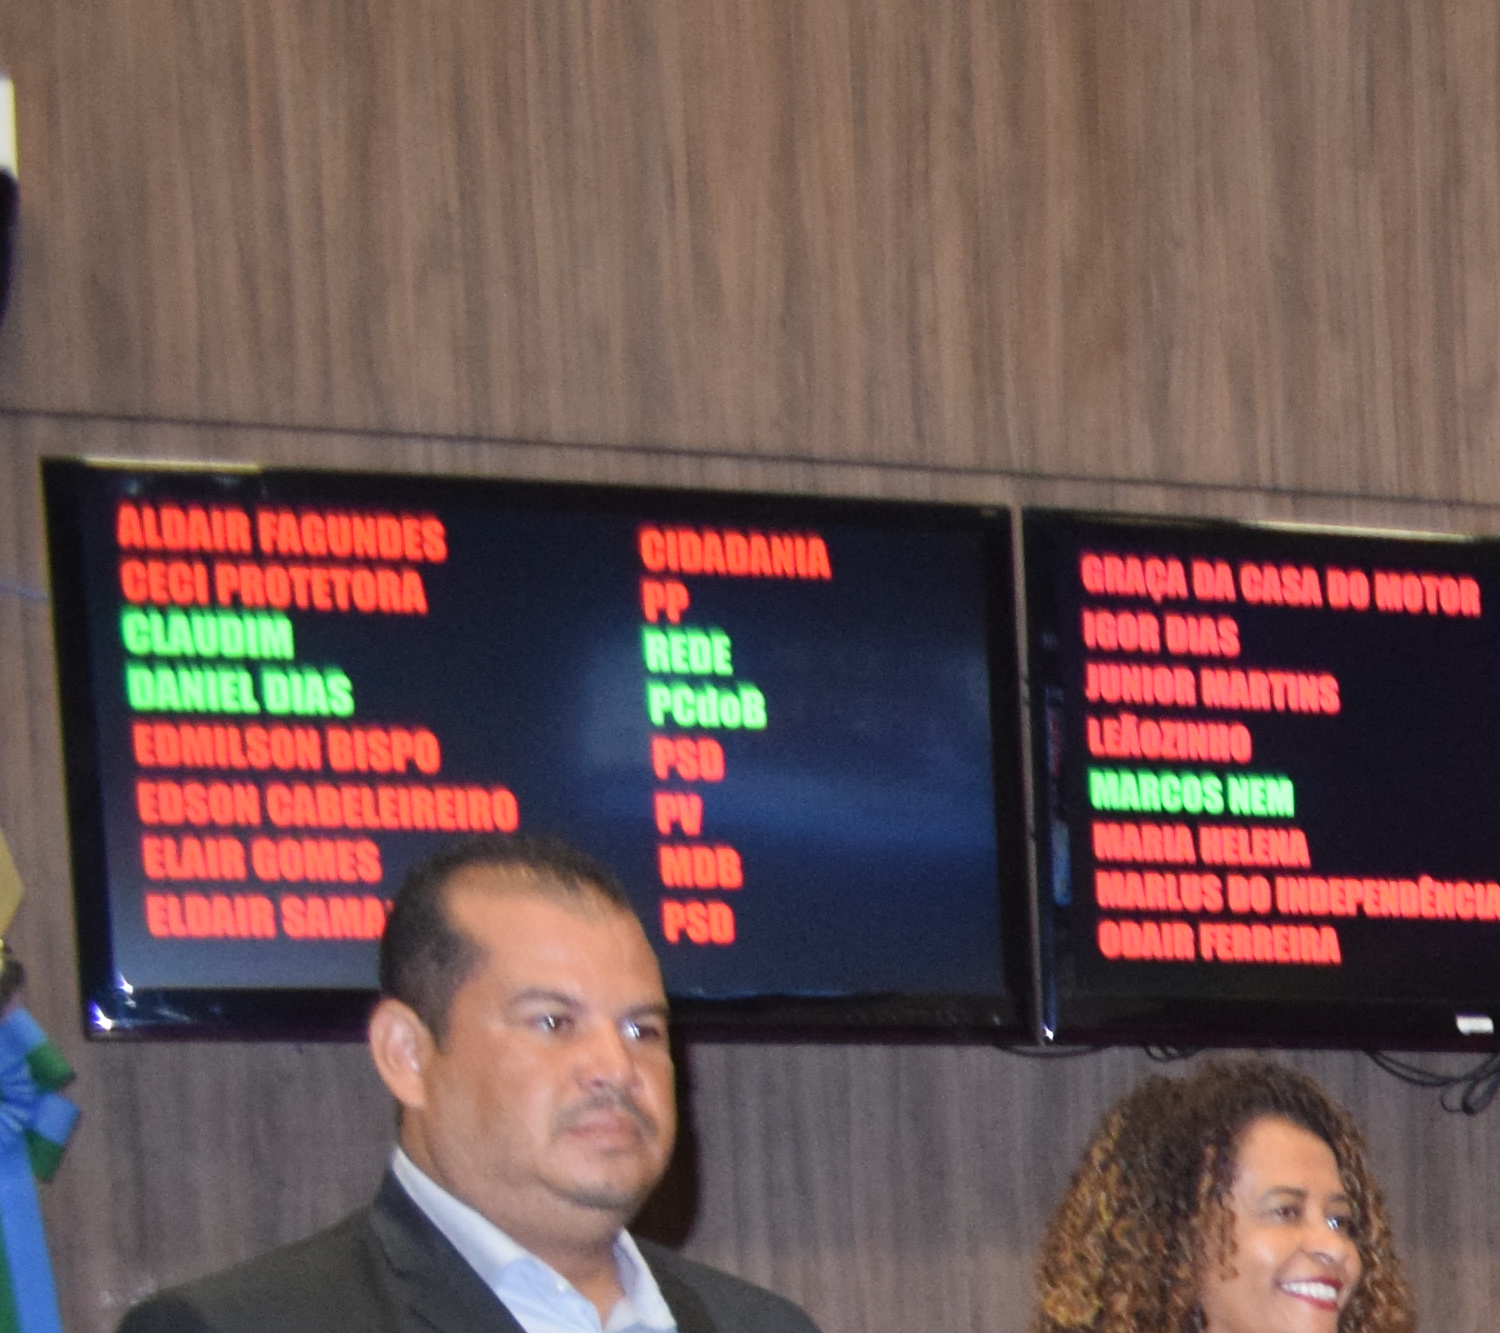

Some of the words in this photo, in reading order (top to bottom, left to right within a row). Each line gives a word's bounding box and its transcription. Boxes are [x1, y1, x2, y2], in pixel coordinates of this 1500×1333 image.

[117, 502, 251, 554] ALDAIR
[260, 510, 446, 563] FAGUNDES
[640, 528, 831, 581] CIDADANIA
[121, 559, 210, 606] CECI
[217, 563, 427, 615] PROTETORA
[642, 579, 688, 624] PP
[1081, 550, 1187, 605] GRAÇA
[1193, 557, 1234, 603] DA
[1241, 561, 1322, 610] CASA
[1328, 566, 1369, 612] DO
[1376, 569, 1480, 617] MOTOR
[123, 610, 293, 659] CLAUDIM
[645, 627, 733, 677] REDE
[1083, 610, 1159, 654] IGOR
[1166, 615, 1239, 659] DIAS
[128, 663, 257, 713] DANIEL
[265, 669, 353, 717] DIAS
[648, 681, 767, 730] PCdoB
[1085, 662, 1195, 709] JUNIOR
[1202, 668, 1340, 715] MARTINS
[134, 721, 321, 771] EDMILSON
[329, 728, 440, 774] BISPO
[652, 735, 724, 782] PSD
[1087, 713, 1252, 766] LEÃOZINHO
[138, 779, 260, 828] EDSON
[267, 784, 518, 833] CABELEIREIRO
[656, 792, 702, 837] PV
[1090, 768, 1223, 815] MARCOS
[1229, 774, 1295, 818] NEM
[144, 835, 245, 881] ELAIR
[253, 838, 381, 884] GOMES
[660, 845, 742, 891] MDB
[1093, 821, 1195, 865] MARIA
[1202, 825, 1310, 869] HELENA
[145, 892, 276, 941] ELDAIR
[280, 893, 394, 942] SAMA
[1095, 870, 1222, 913] MARLUS
[1228, 877, 1270, 915] DO
[664, 899, 735, 946] PSD
[1098, 919, 1195, 962] ODAIR
[1202, 923, 1341, 968] FERREIRA
